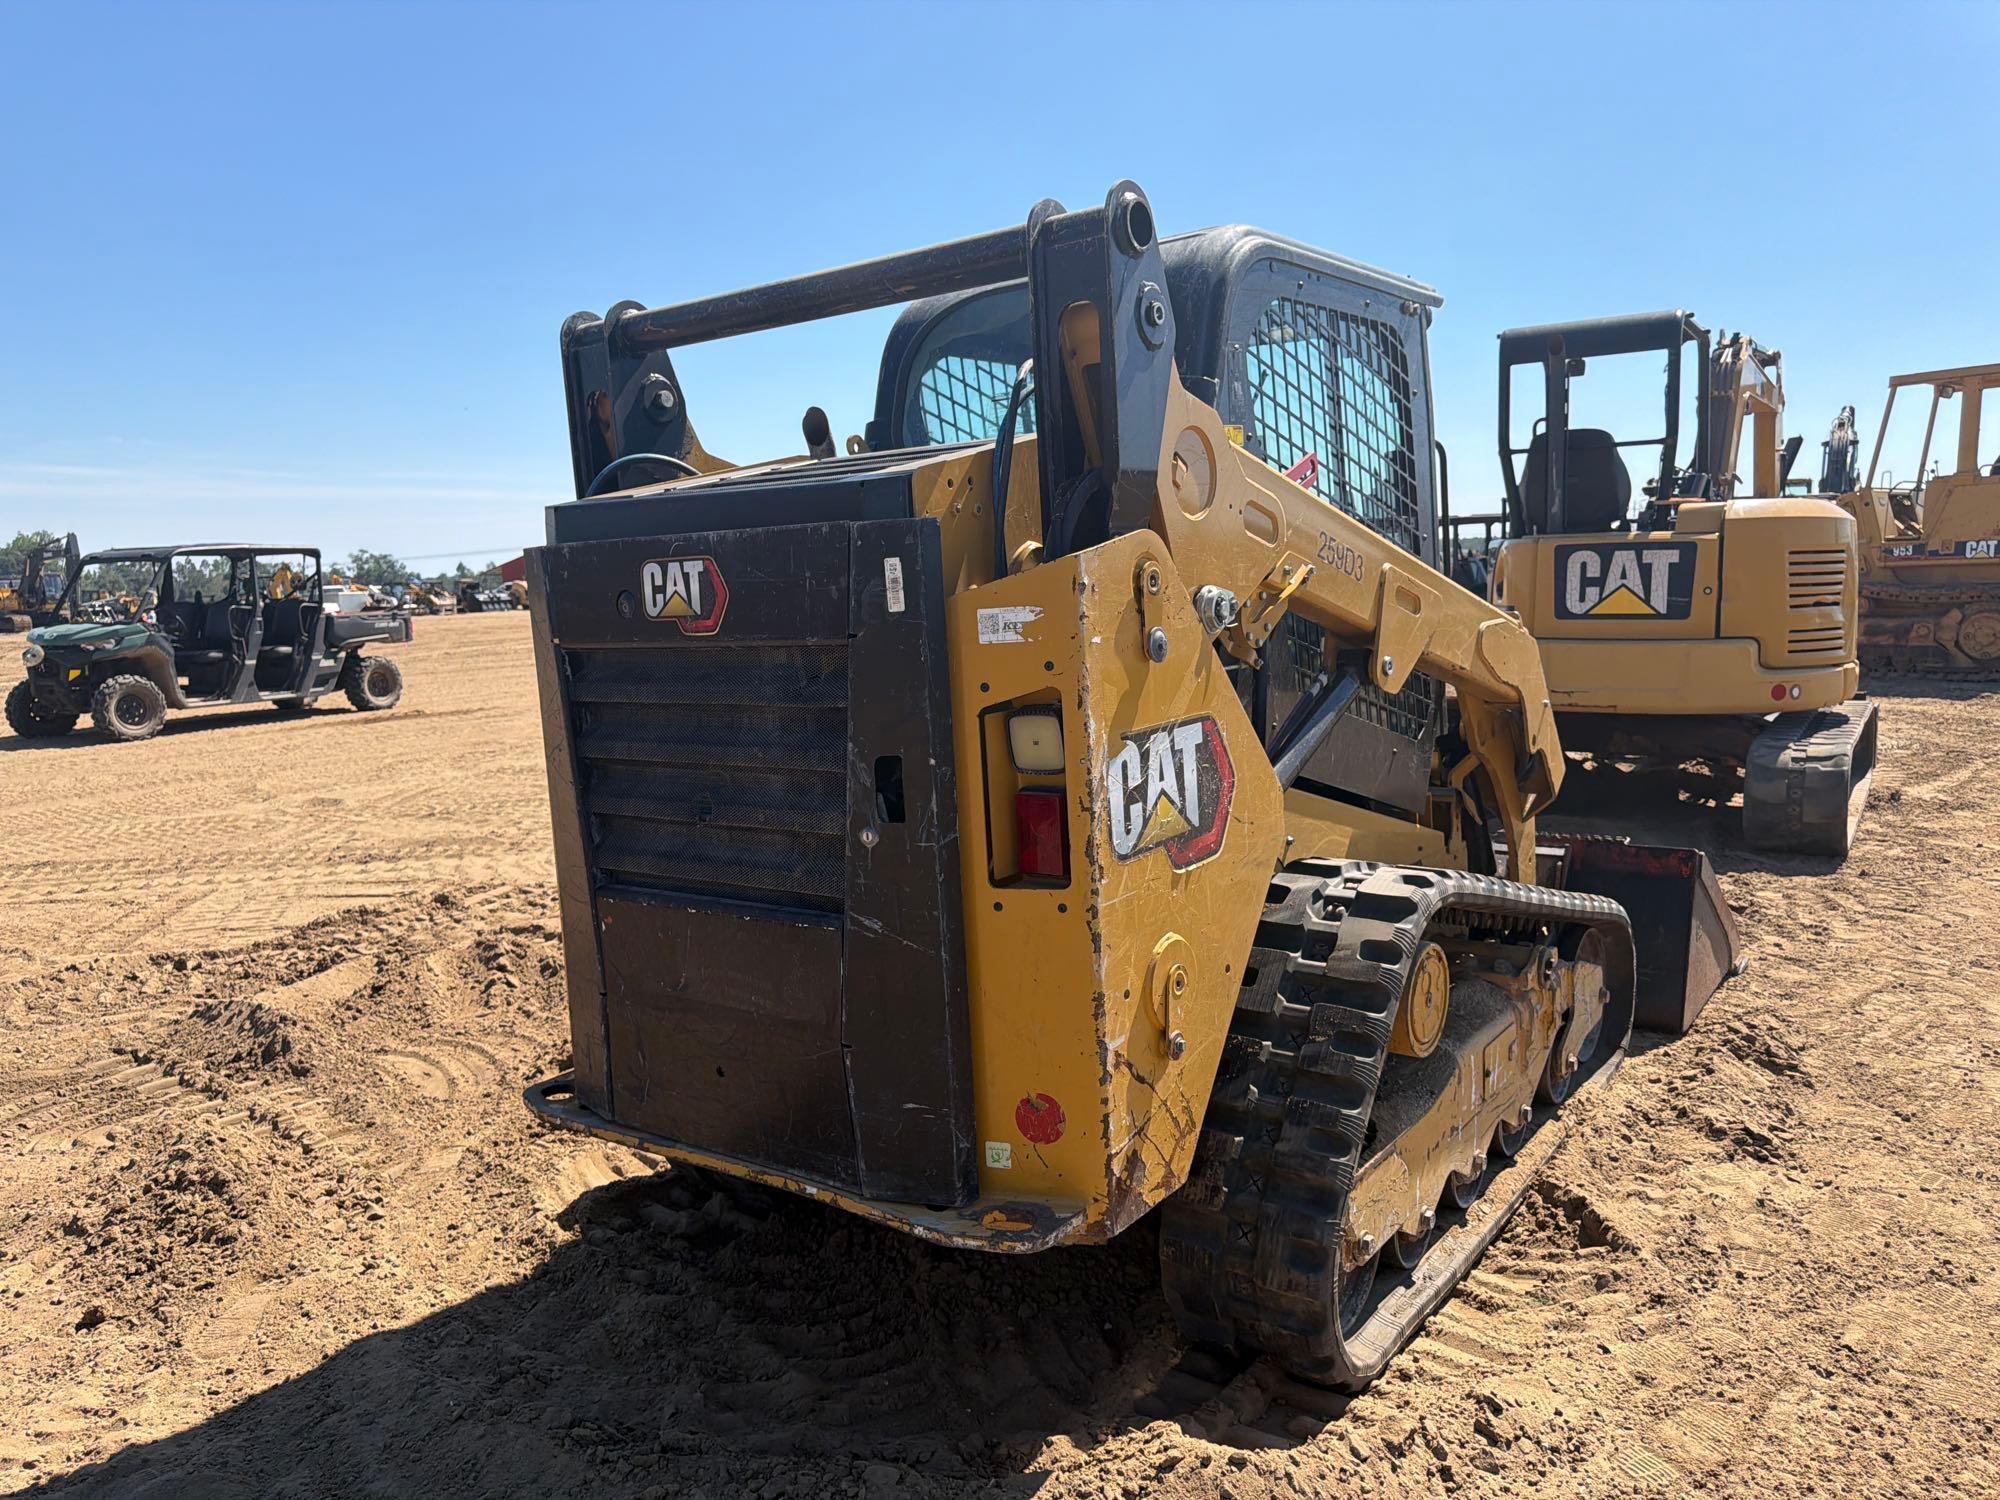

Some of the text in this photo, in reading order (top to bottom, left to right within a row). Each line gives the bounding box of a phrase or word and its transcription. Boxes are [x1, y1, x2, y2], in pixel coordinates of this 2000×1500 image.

[1317, 531, 1363, 581] 259D3
[1892, 545, 1913, 557] 953
[1965, 540, 1998, 558] CAT
[643, 560, 704, 617] CAT
[1566, 549, 1680, 614] CAT
[1107, 721, 1203, 854] CAT
